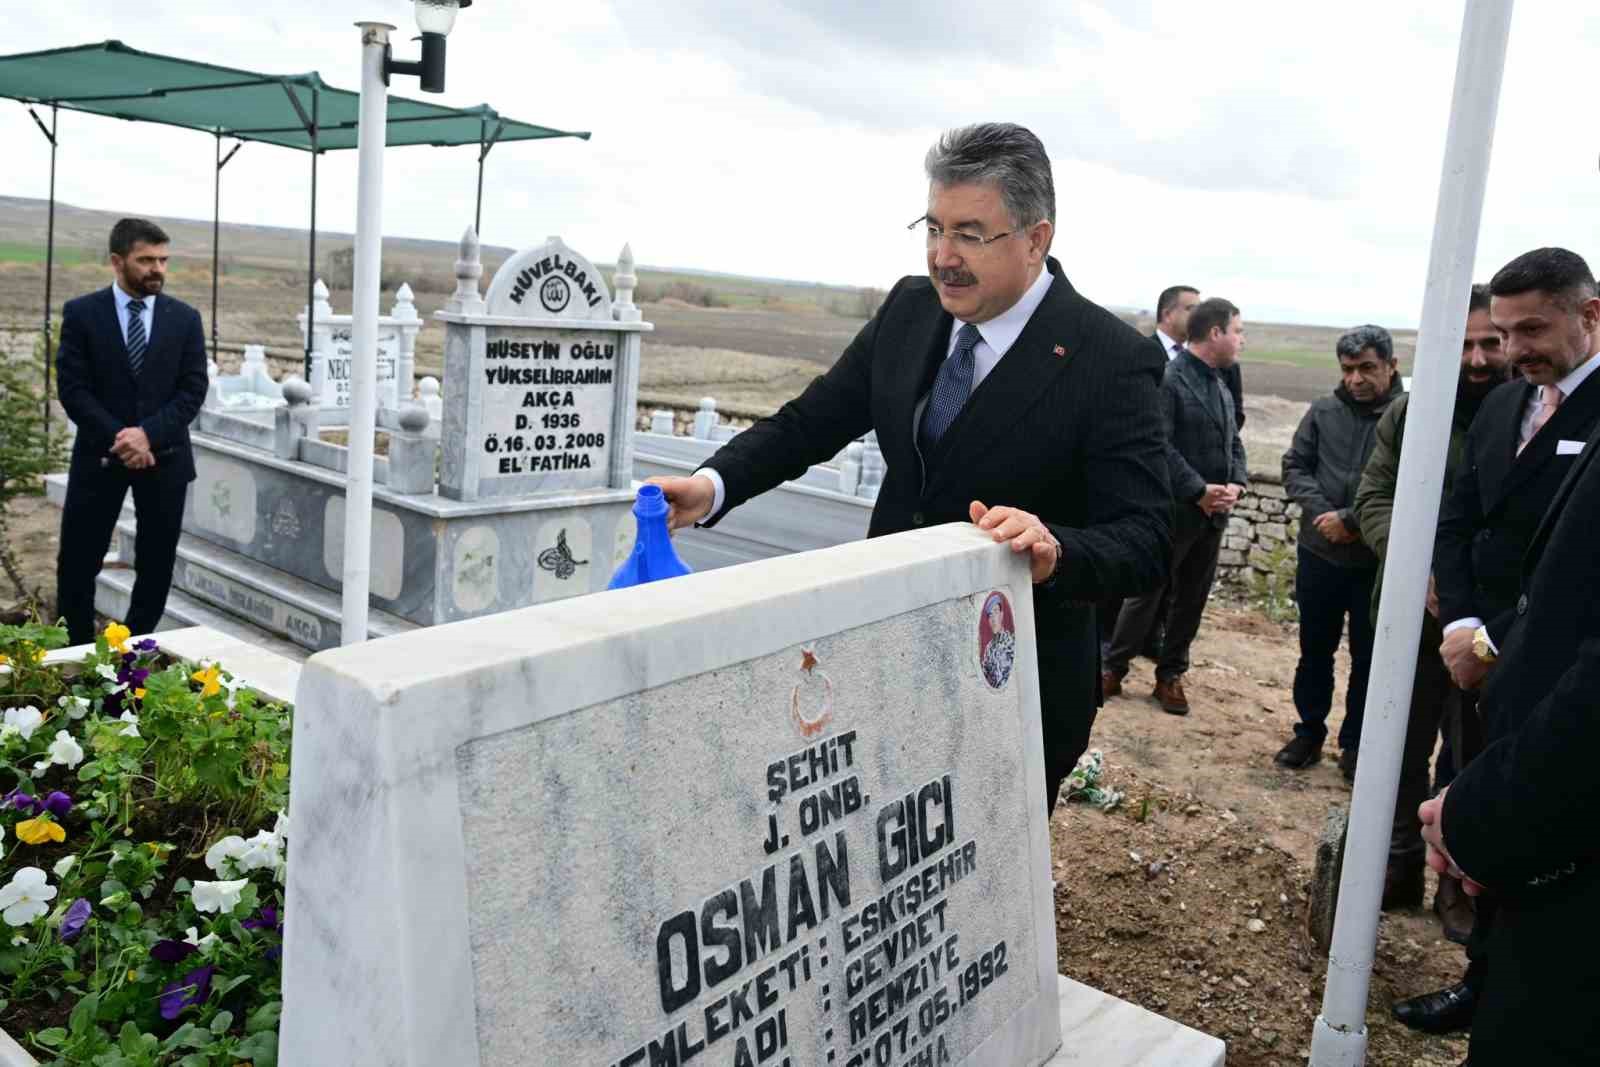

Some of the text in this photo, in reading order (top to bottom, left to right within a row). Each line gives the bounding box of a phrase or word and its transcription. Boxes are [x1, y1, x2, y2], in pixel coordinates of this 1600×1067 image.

[486, 339, 614, 360] HÜSEYİN OĞLU
[515, 413, 580, 430] D. 1936
[522, 391, 575, 410] AKÇA
[499, 452, 591, 474] EL FATİHA
[766, 730, 857, 804] ŞEHİT
[763, 775, 870, 855] J. ONB.
[657, 829, 851, 1014] OSMAN
[842, 840, 977, 955] ESKİŞEHİR
[845, 899, 948, 999] CEVDET
[850, 934, 961, 1046] REMZİYE
